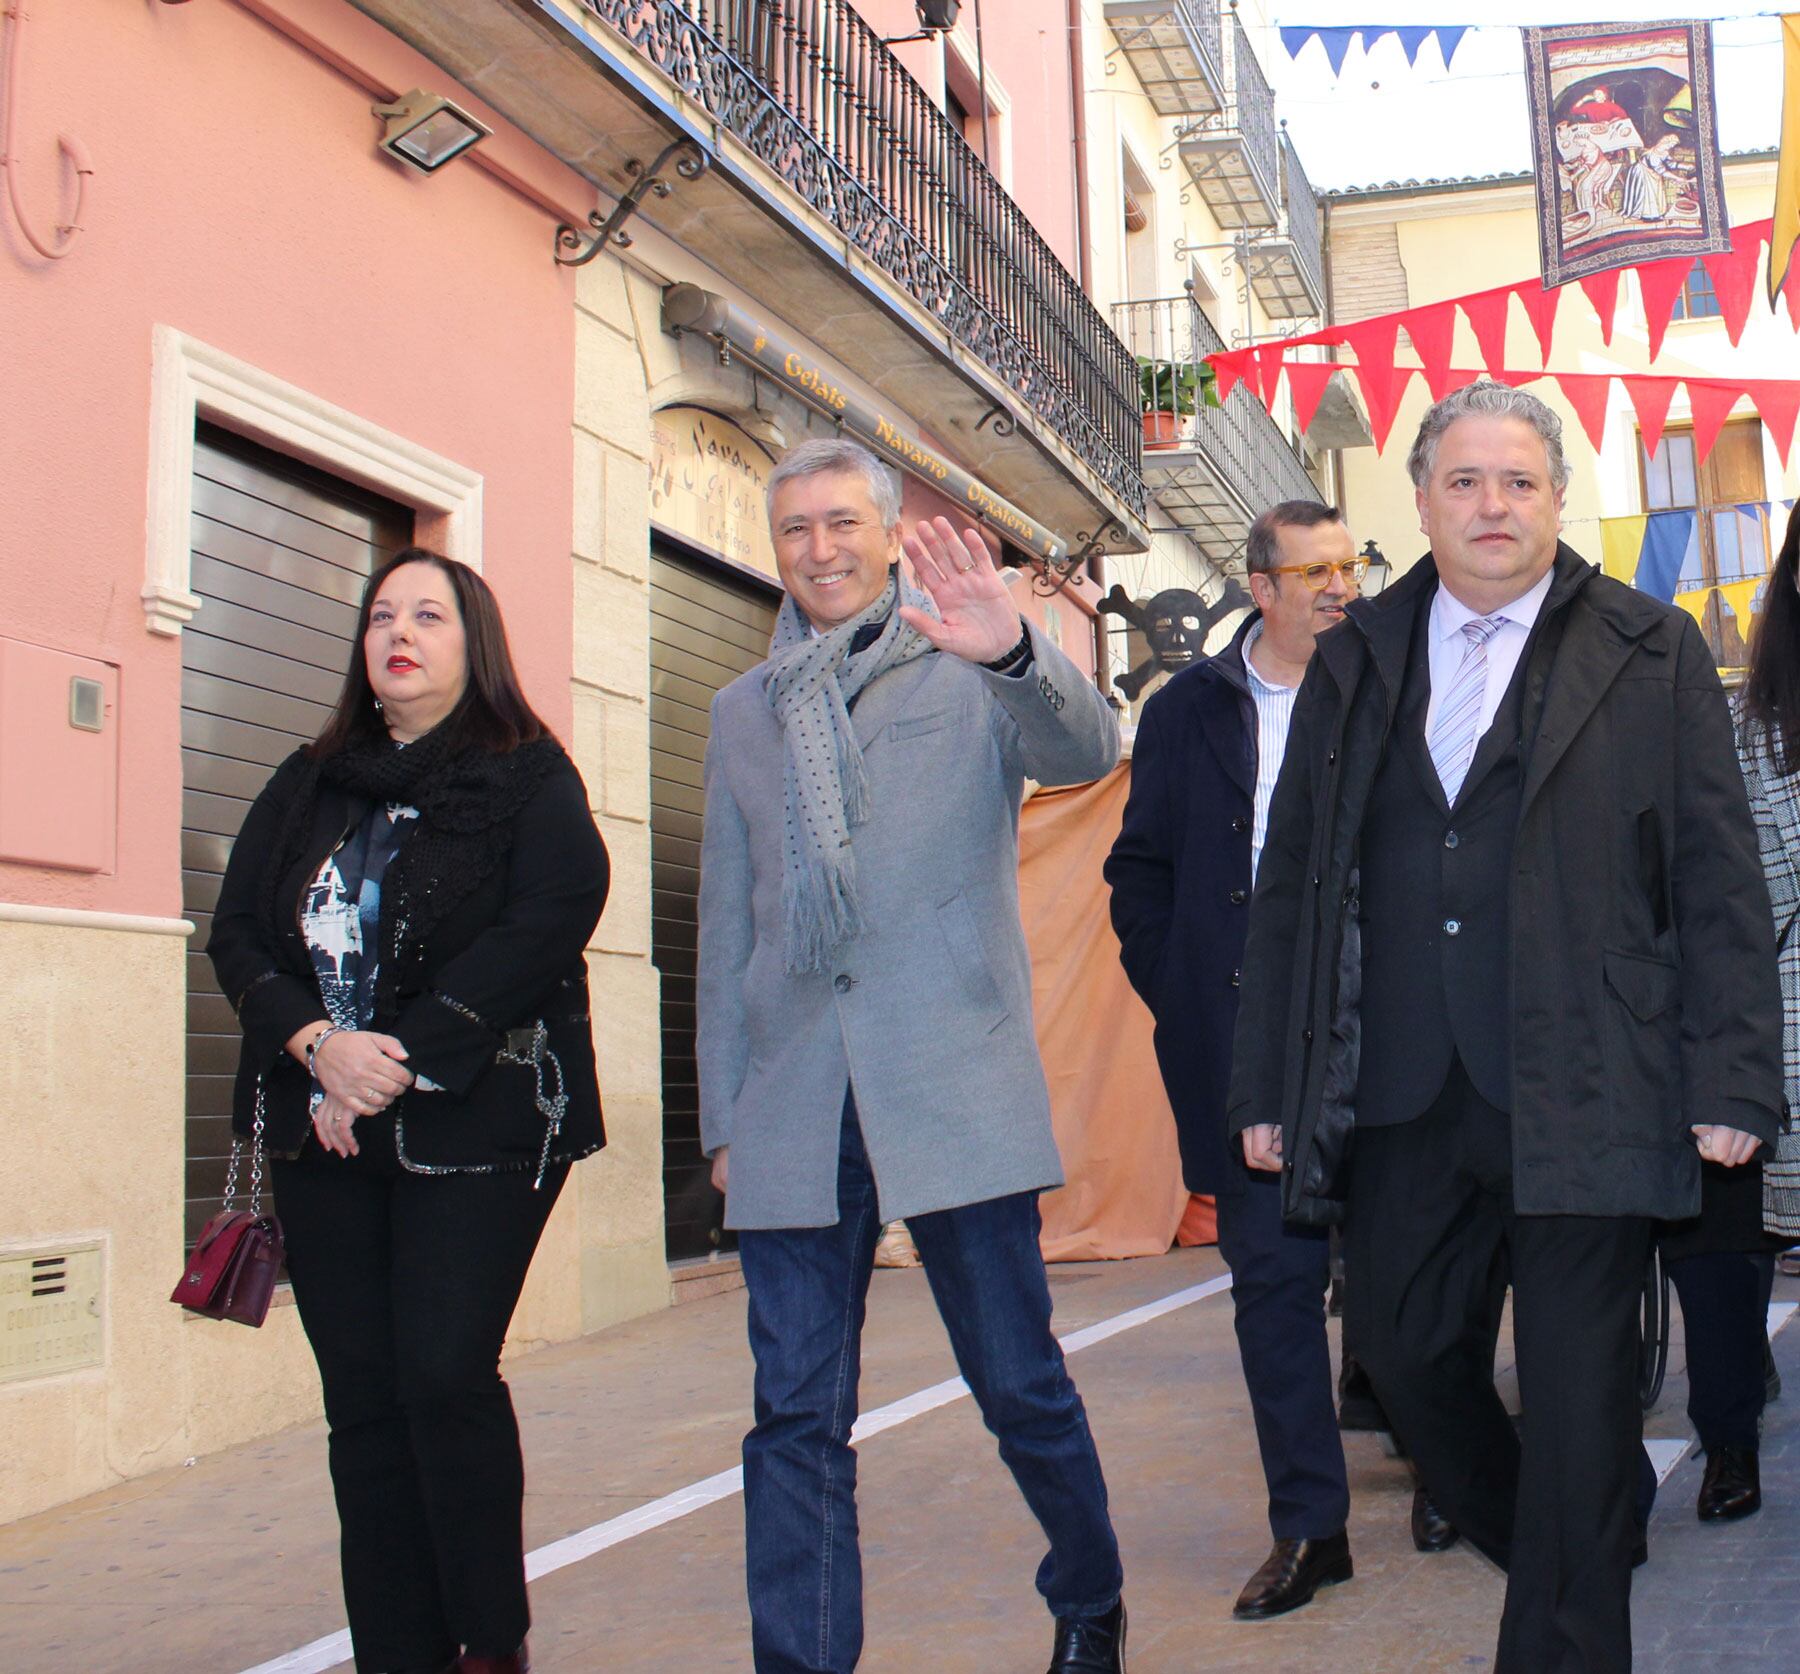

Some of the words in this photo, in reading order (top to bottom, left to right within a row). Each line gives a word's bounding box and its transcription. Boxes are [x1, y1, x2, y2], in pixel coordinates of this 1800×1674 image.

[784, 352, 847, 410] Gelats
[875, 414, 949, 481] Navarro
[967, 480, 1033, 541] Orxateria
